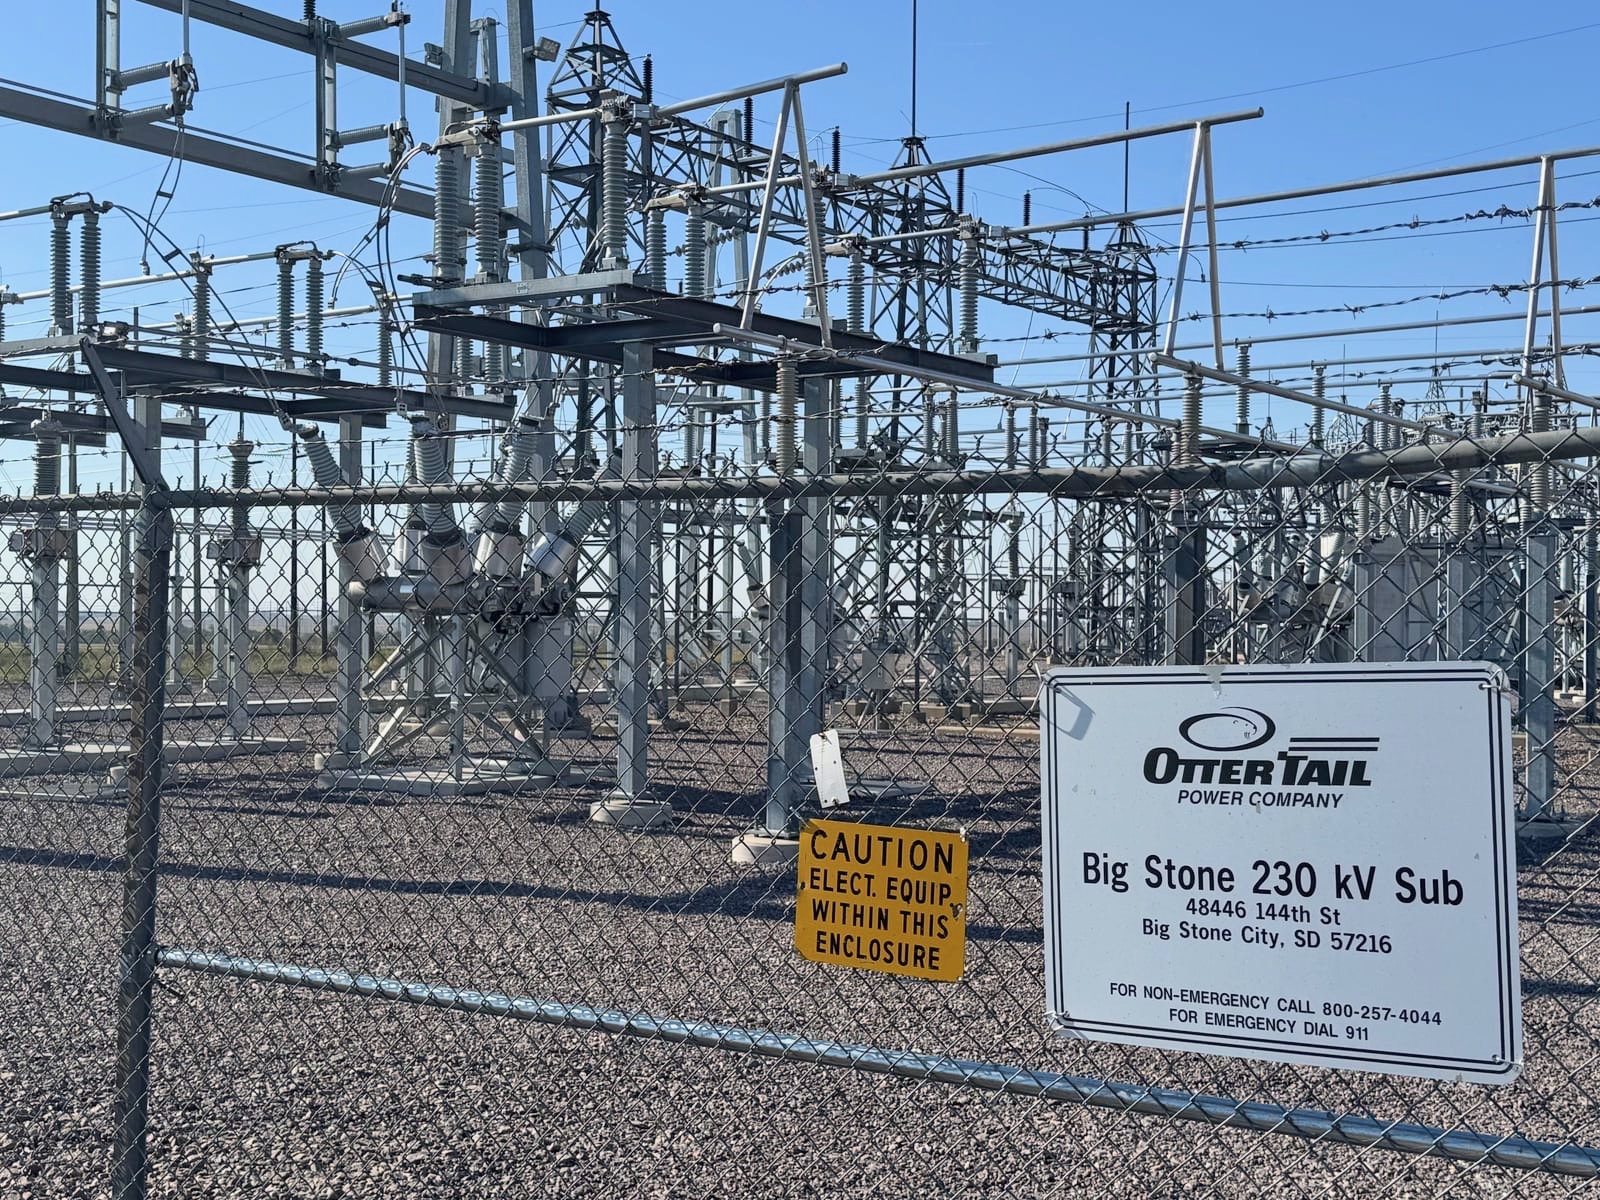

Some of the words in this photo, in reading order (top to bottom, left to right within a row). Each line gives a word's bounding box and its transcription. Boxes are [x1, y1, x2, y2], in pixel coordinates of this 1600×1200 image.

[1143, 747, 1275, 786] OTTER
[1277, 750, 1373, 787] TAIL
[1177, 789, 1244, 806] POWER
[1249, 791, 1344, 809] COMPANY
[810, 829, 954, 875] CAUTION
[809, 867, 876, 898] ELECT.
[1083, 851, 1129, 893] Big
[1144, 854, 1235, 893] Stone
[1251, 859, 1317, 898] 230
[1334, 864, 1377, 901] kV
[1395, 866, 1464, 906] Sub
[812, 898, 889, 931] WITHIN
[899, 910, 949, 940] THIS
[1185, 897, 1247, 919] 48446
[1256, 902, 1311, 923] 144th
[1319, 906, 1341, 926] St
[816, 930, 940, 971] ENCLOSURE
[1142, 918, 1171, 941] Big
[1179, 920, 1232, 942] Stone
[1241, 925, 1285, 949] City,
[1294, 929, 1321, 949] SD
[1330, 932, 1393, 954] 57216
[1110, 982, 1137, 998] FOR
[1143, 985, 1270, 1010] NON-EMERGENCY
[1277, 998, 1316, 1015] CALL
[1323, 1002, 1442, 1026] 800-257-4044
[1169, 1008, 1198, 1024] FOR
[1205, 1011, 1297, 1034] EMERGENCY
[1303, 1021, 1339, 1038] DIAL
[1346, 1025, 1369, 1041] 911
